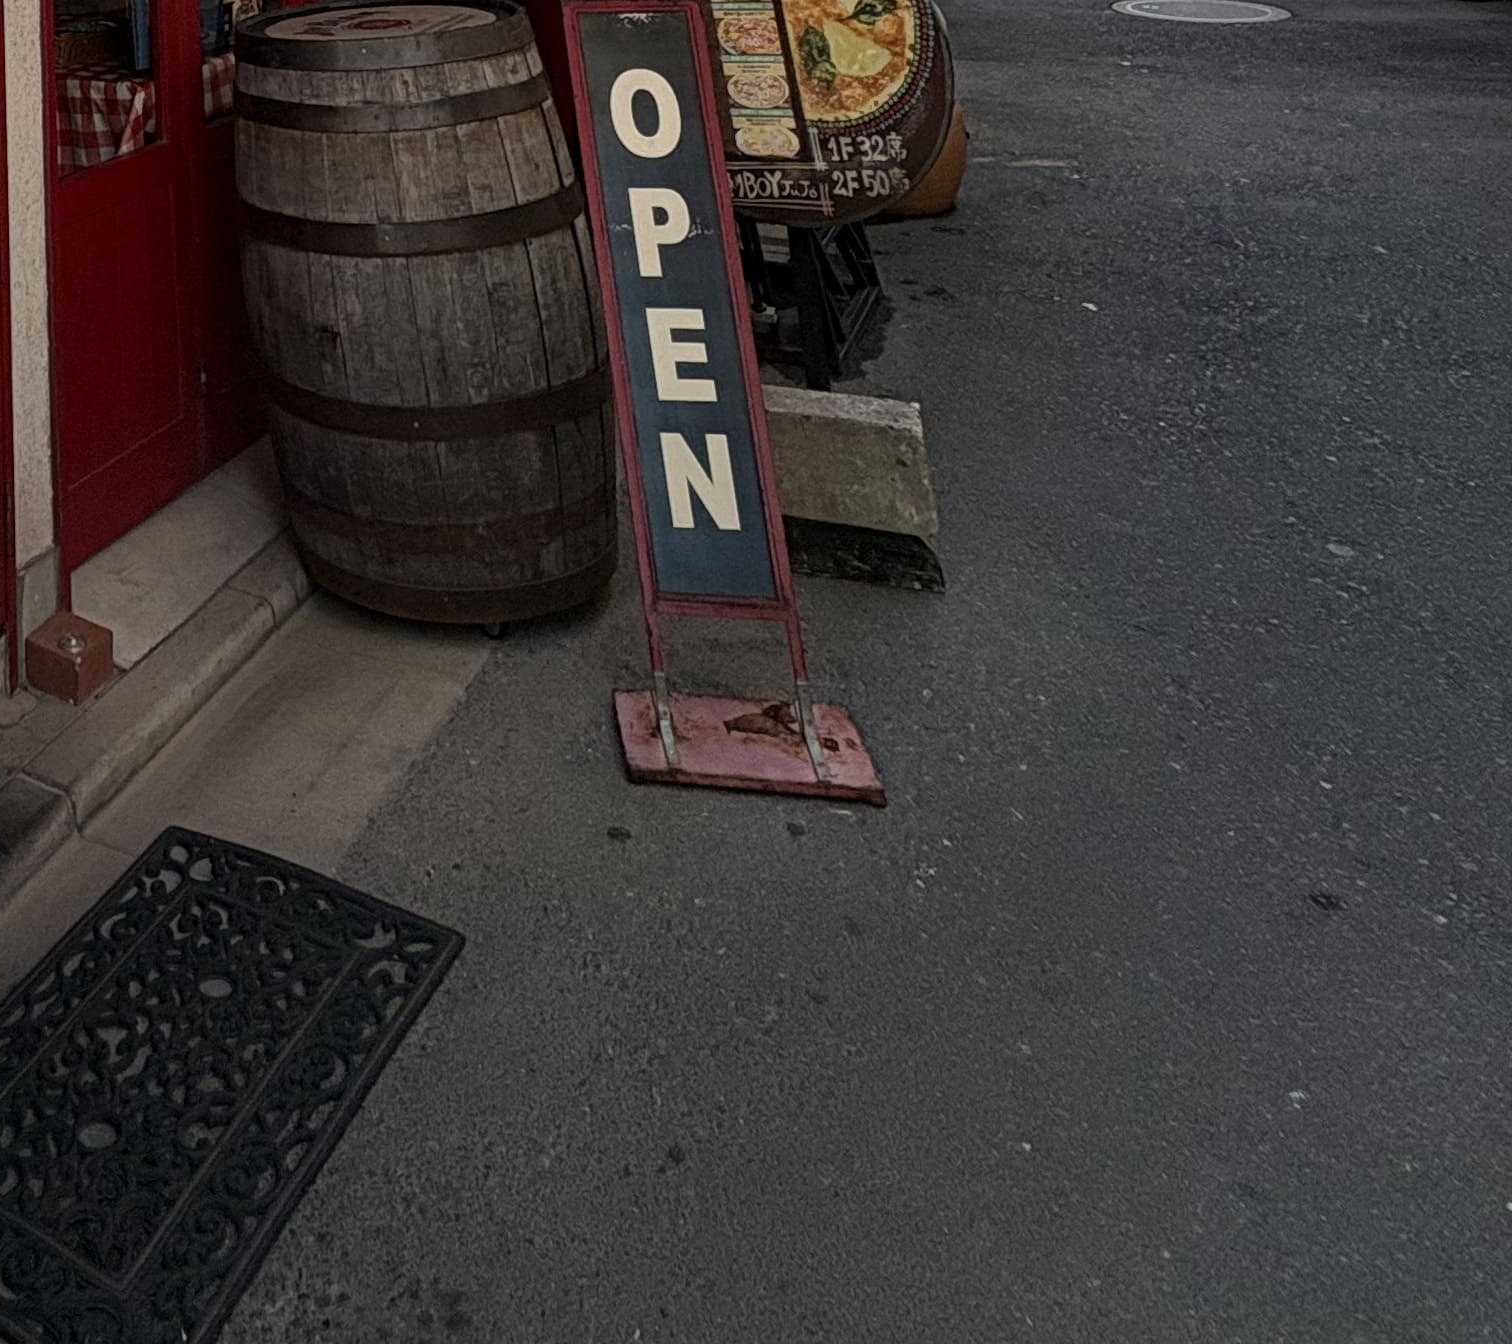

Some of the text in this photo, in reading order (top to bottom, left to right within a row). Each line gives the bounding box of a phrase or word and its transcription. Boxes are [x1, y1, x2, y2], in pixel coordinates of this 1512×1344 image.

[827, 135, 854, 161] 1F
[831, 170, 860, 197] 2F
[609, 68, 742, 531] OPEN
